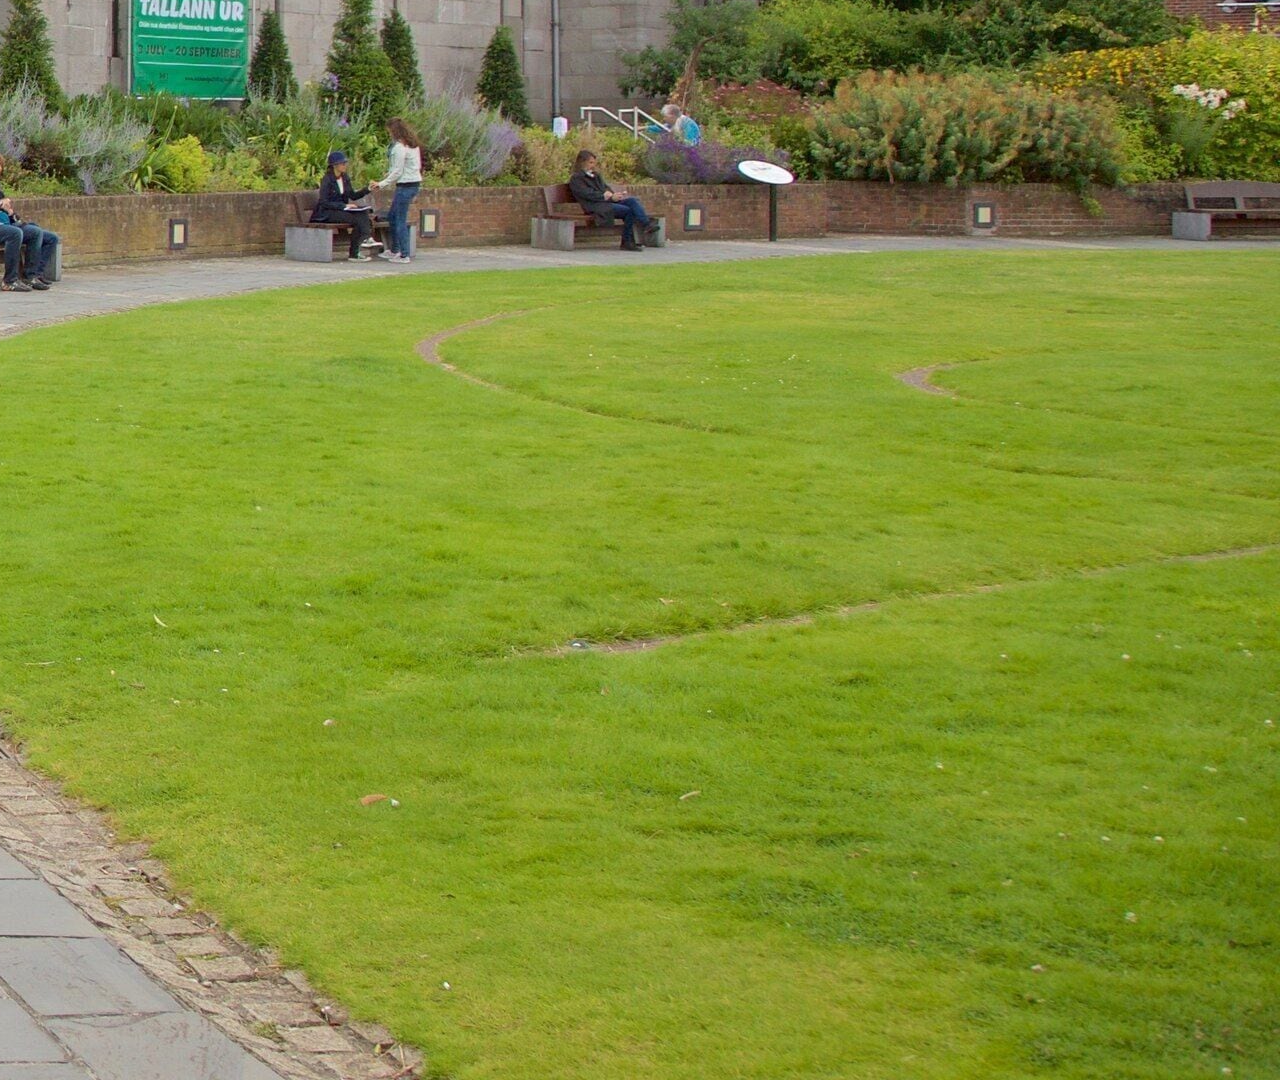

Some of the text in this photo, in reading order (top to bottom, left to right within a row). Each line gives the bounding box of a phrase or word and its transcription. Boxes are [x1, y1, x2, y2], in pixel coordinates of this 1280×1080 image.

[146, 45, 166, 55] JULY
[176, 46, 187, 56] 20
[189, 47, 241, 58] SEPTEMBER
